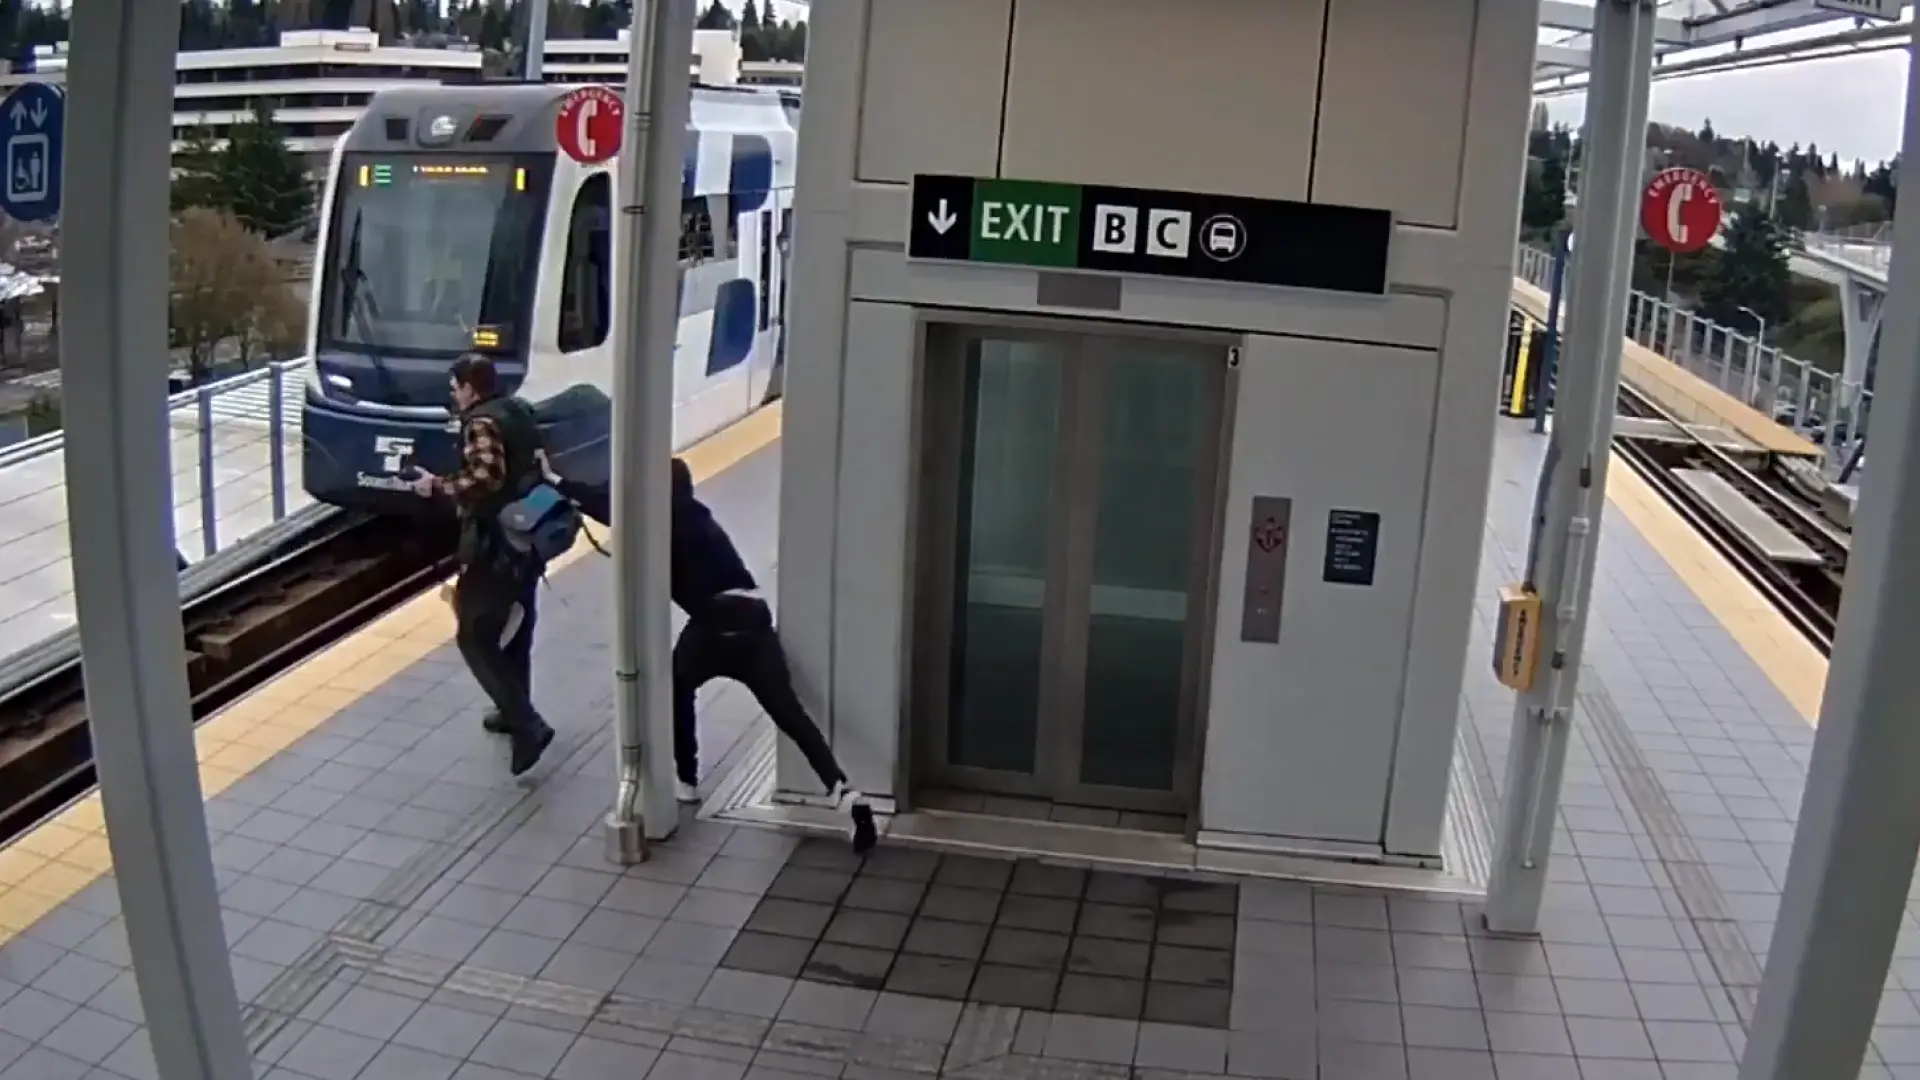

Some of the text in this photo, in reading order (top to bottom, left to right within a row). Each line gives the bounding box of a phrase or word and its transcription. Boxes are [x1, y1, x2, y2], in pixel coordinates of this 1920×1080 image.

[1648, 171, 1718, 204] EMERGENCY
[980, 201, 1179, 249] EXIT B C
[1230, 348, 1239, 367] 3
